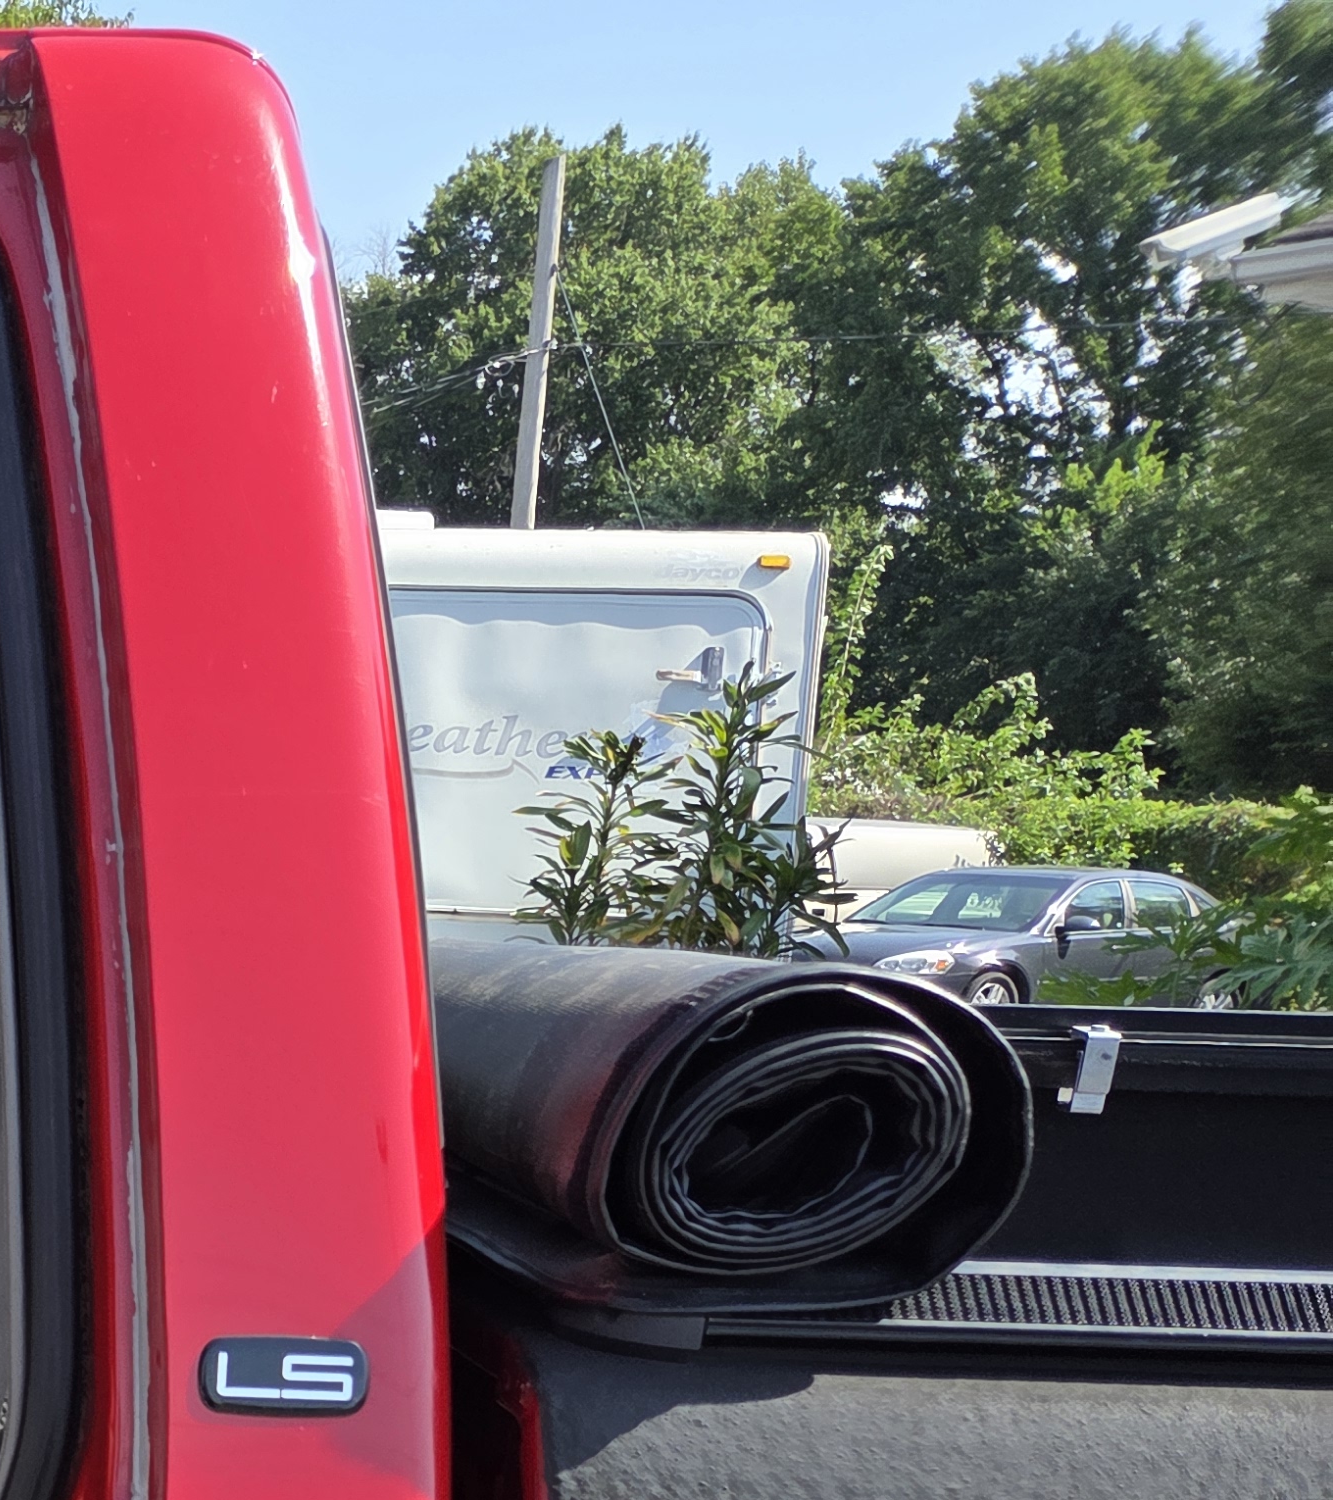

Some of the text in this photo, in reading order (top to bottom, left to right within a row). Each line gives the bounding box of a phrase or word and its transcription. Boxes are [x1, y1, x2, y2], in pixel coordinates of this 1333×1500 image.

[654, 563, 740, 582] Jayco
[406, 714, 589, 759] eathe
[216, 1351, 354, 1402] LS
